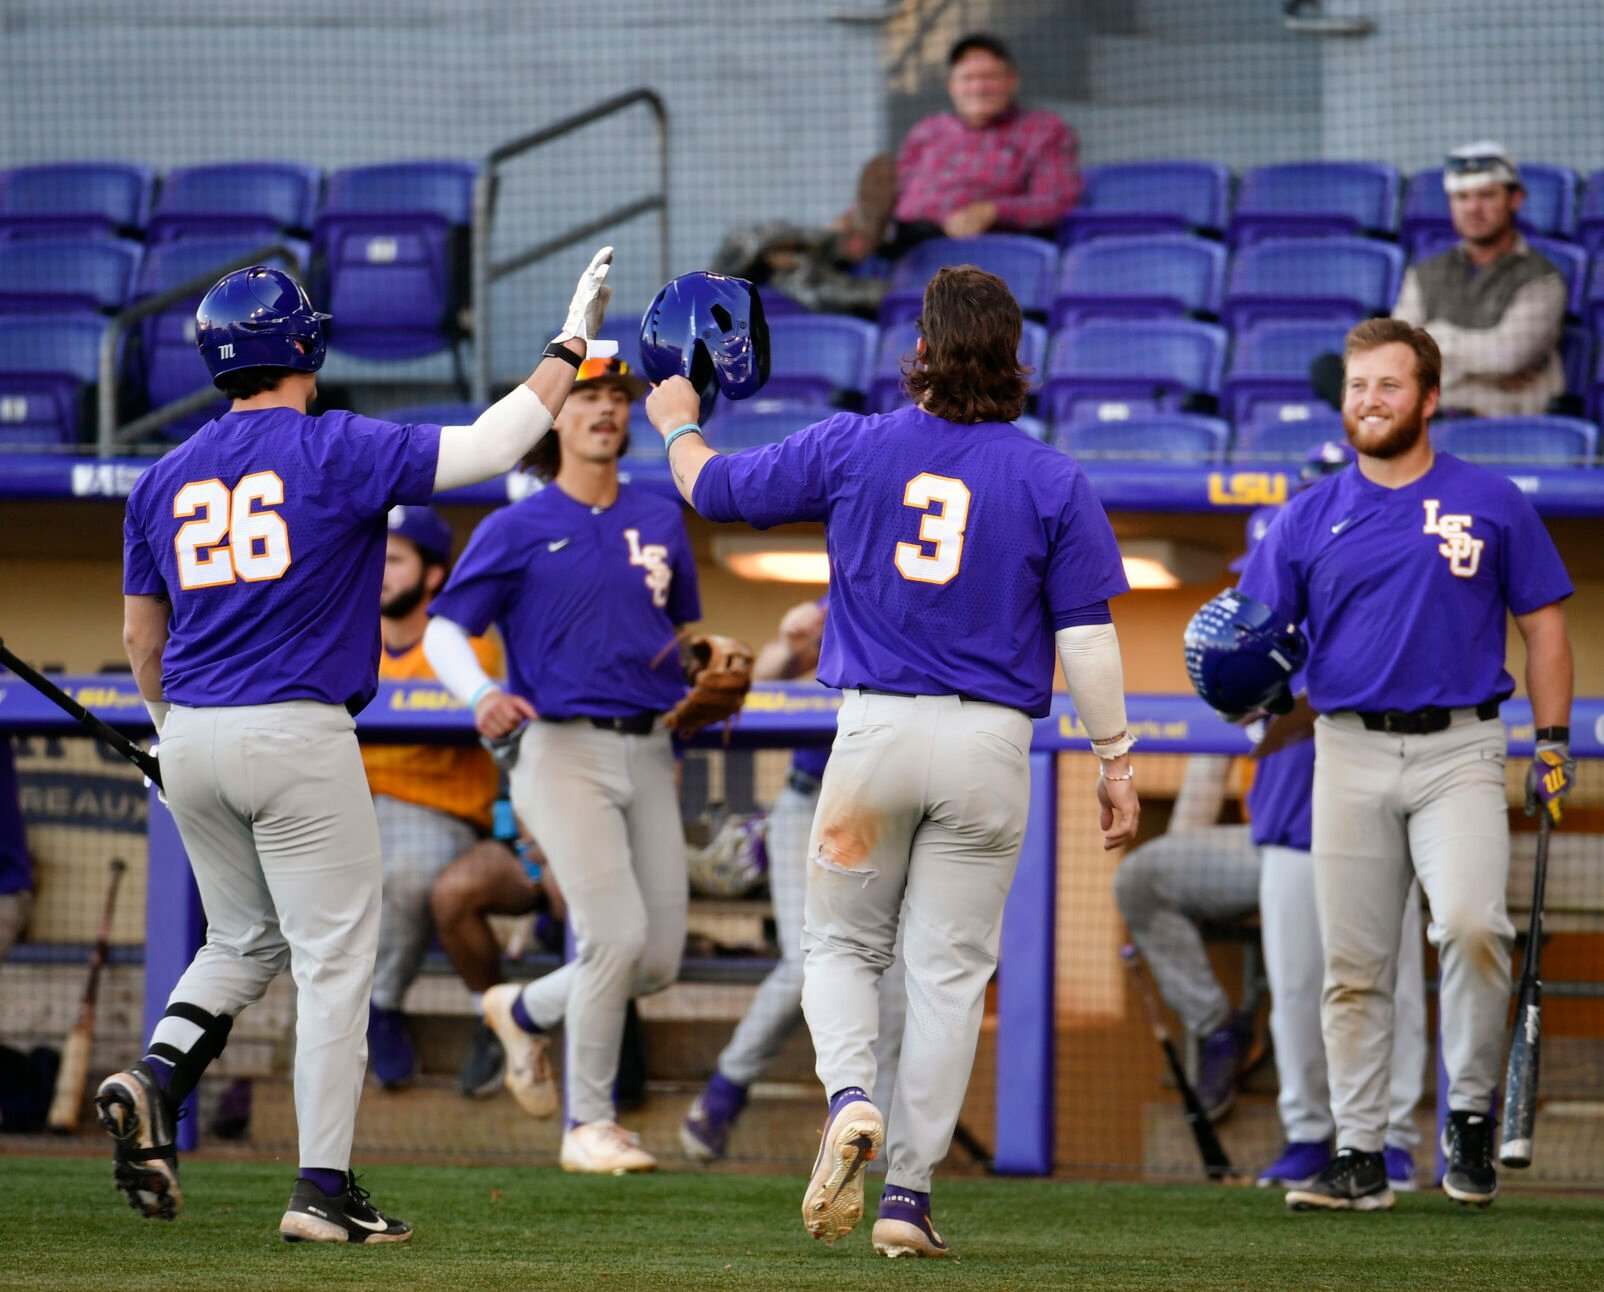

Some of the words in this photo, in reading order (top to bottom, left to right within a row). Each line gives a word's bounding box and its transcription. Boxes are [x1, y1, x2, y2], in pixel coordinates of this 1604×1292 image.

[894, 471, 972, 585] 3
[1208, 472, 1287, 507] LSU
[173, 469, 292, 591] 26
[624, 528, 673, 607] LSU
[1423, 499, 1484, 577] LSU
